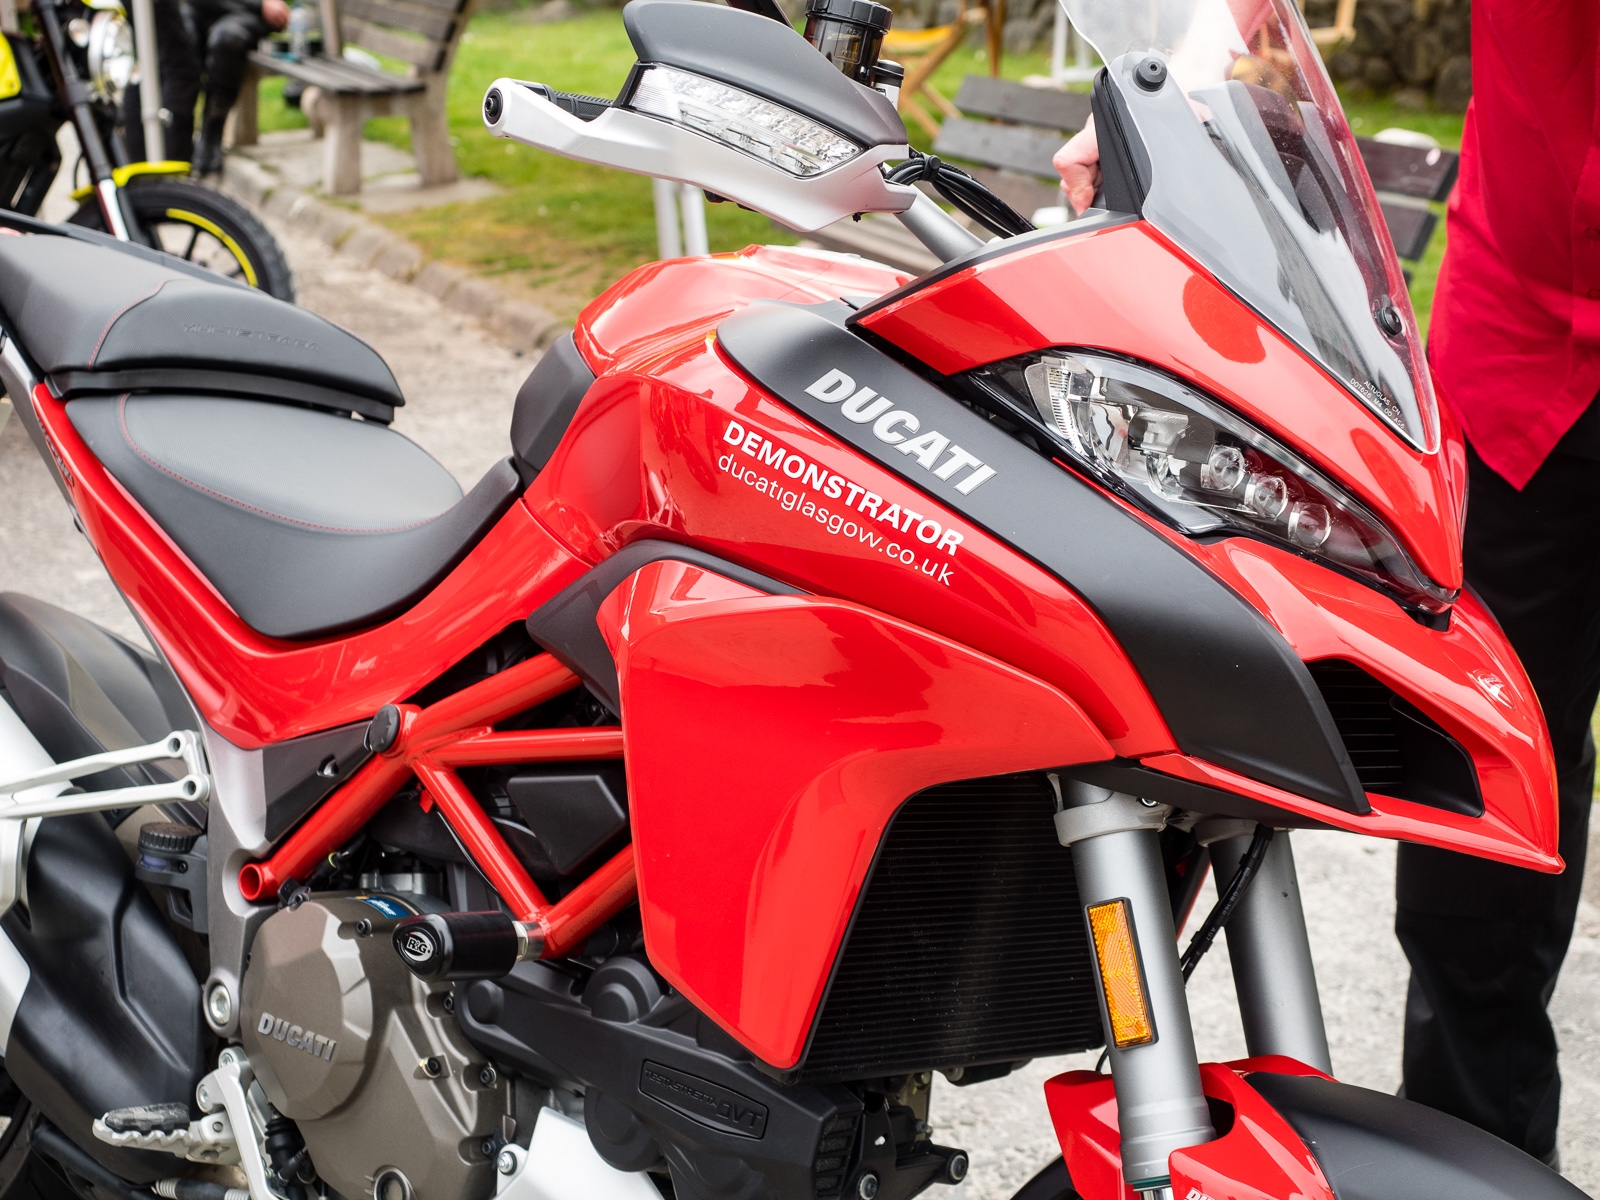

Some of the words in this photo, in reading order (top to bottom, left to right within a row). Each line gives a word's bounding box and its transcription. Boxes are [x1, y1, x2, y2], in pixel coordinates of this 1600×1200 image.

[1364, 381, 1390, 406] ALTUGLAS
[804, 368, 997, 496] DUCATI
[723, 420, 964, 555] DEMONSTRATOR
[718, 454, 954, 586] ducatiglasgow.co.uk
[406, 937, 427, 954] R&G
[257, 1012, 337, 1061] DUCATI
[645, 1069, 717, 1108] TESTASTRETTA
[716, 1100, 763, 1129] DVT
